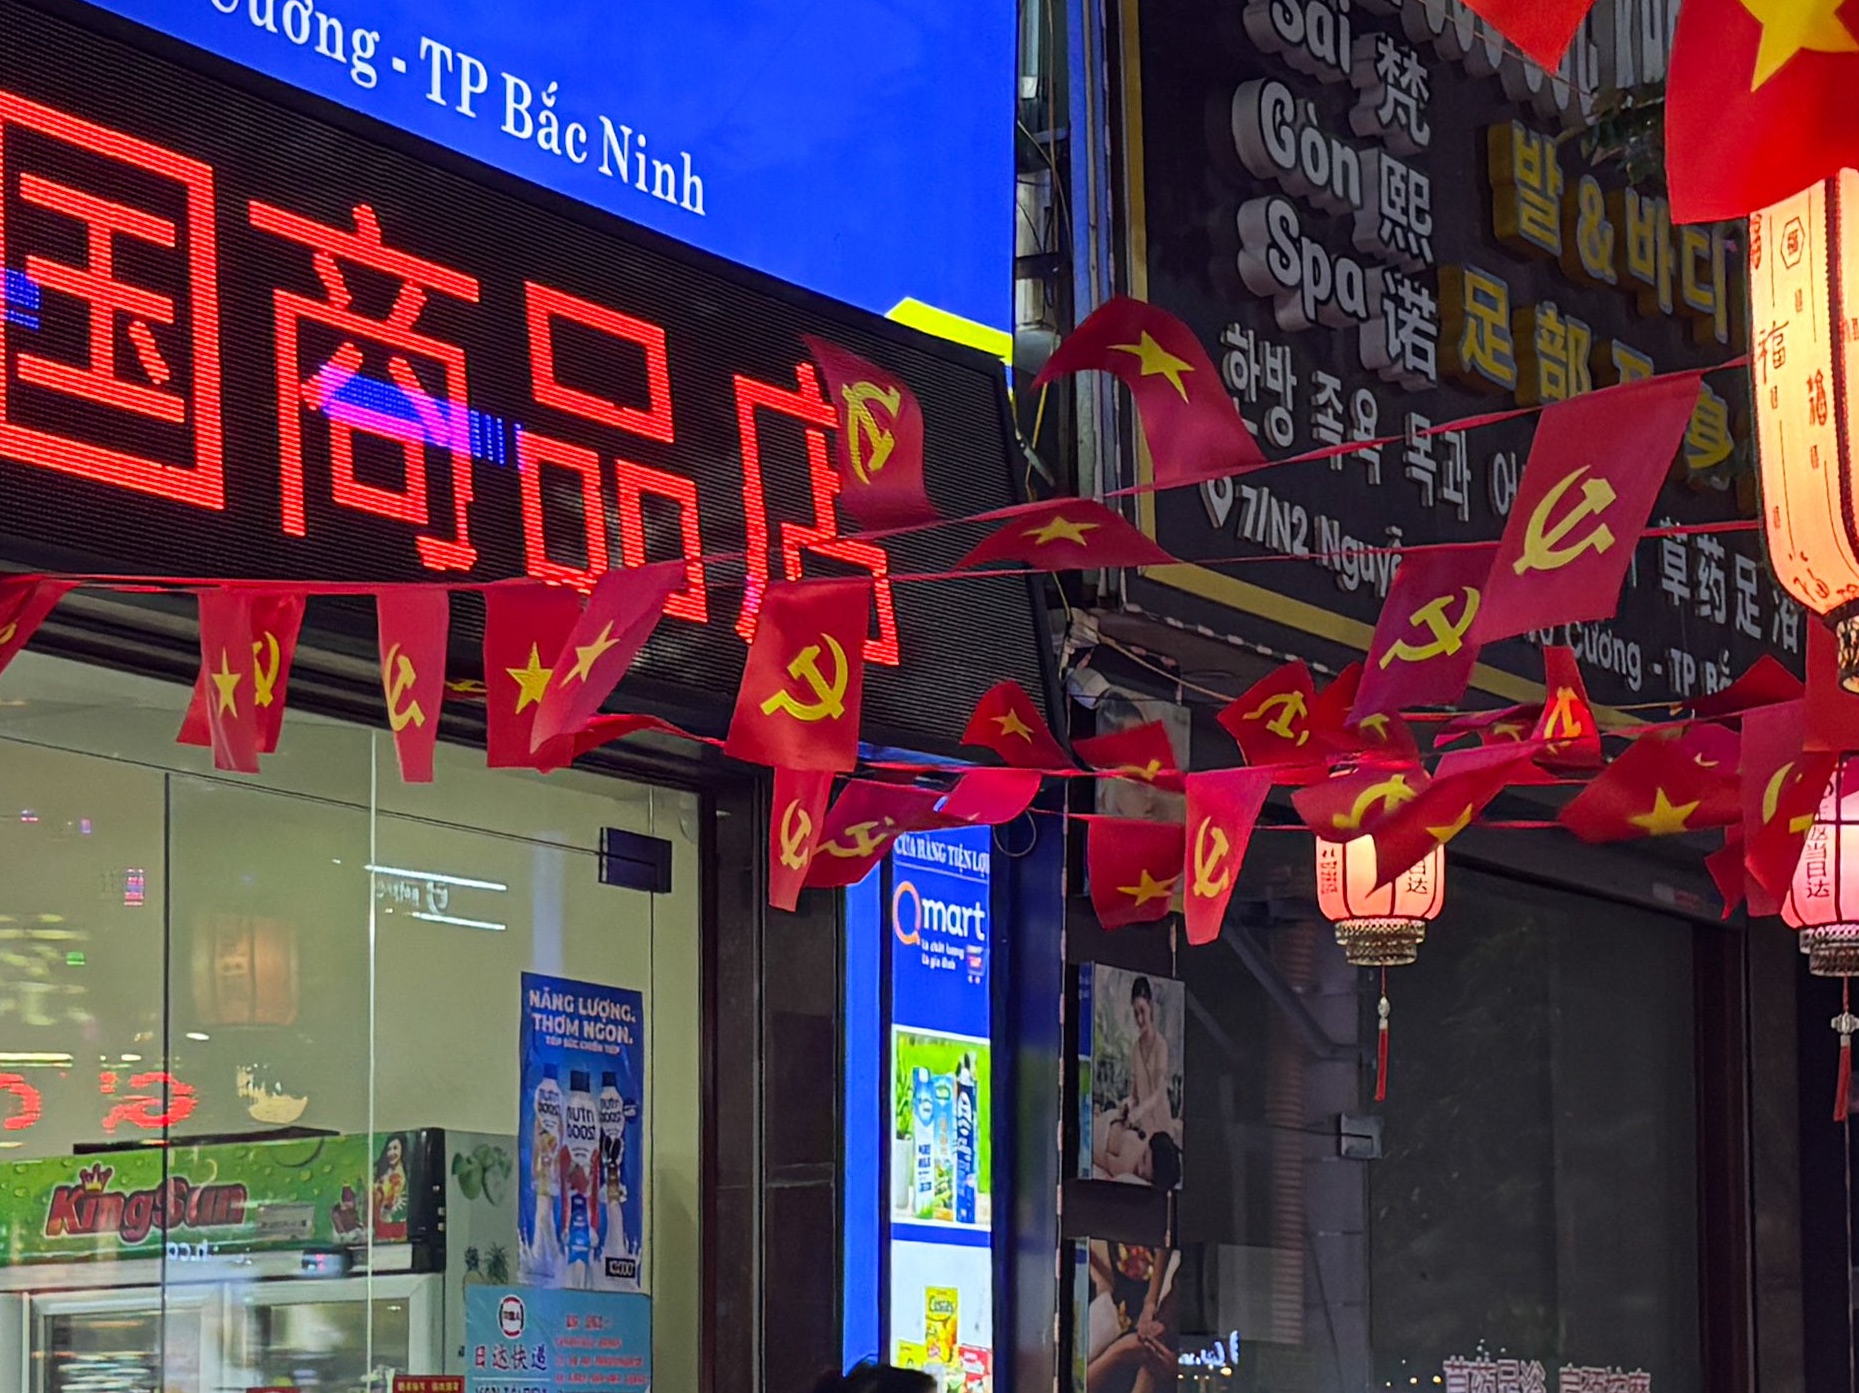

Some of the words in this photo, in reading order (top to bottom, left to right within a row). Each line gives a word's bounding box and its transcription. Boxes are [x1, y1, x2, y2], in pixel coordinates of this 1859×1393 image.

[420, 36, 488, 119] TP
[500, 79, 588, 165] Bắc
[600, 115, 706, 217] Ninh
[1267, 198, 1368, 323] Spa
[893, 880, 985, 945] Qmart
